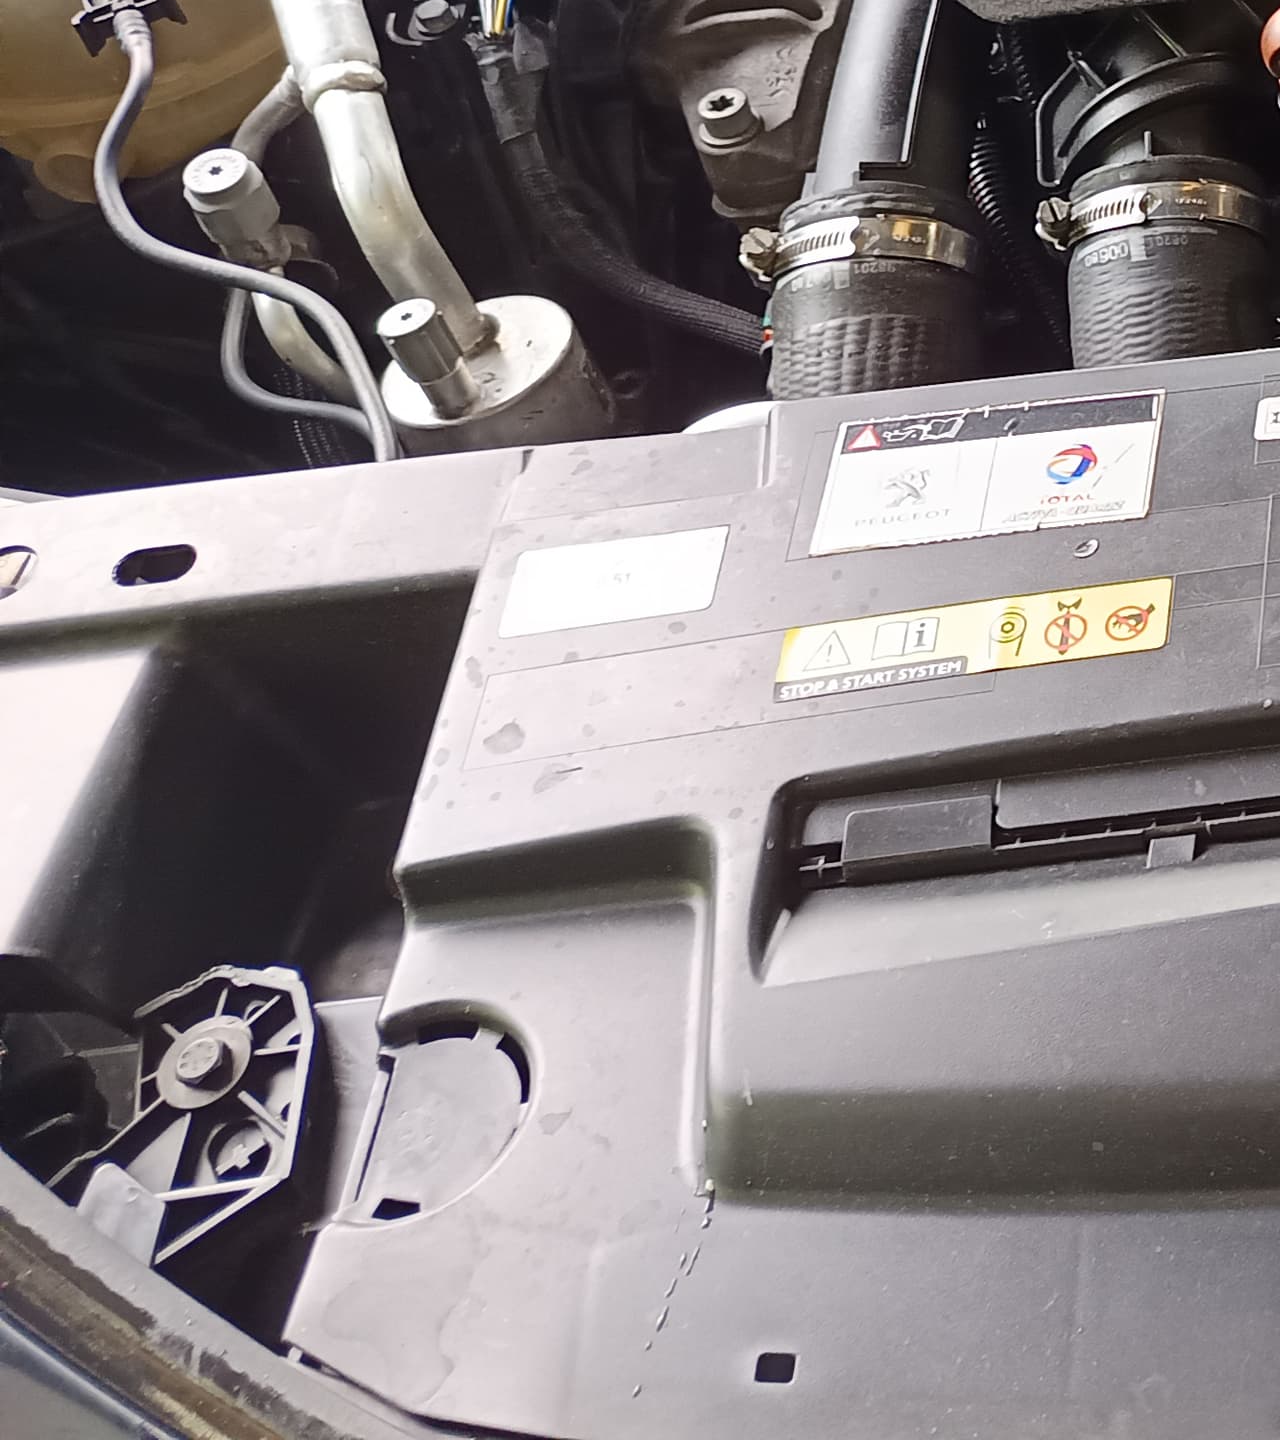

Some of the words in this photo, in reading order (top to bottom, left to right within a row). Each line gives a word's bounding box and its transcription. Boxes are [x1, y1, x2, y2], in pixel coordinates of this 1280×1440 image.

[1040, 493, 1095, 505] TOTAL
[779, 681, 826, 699] STOP
[842, 669, 897, 690] START
[897, 660, 962, 680] SYSTEM
